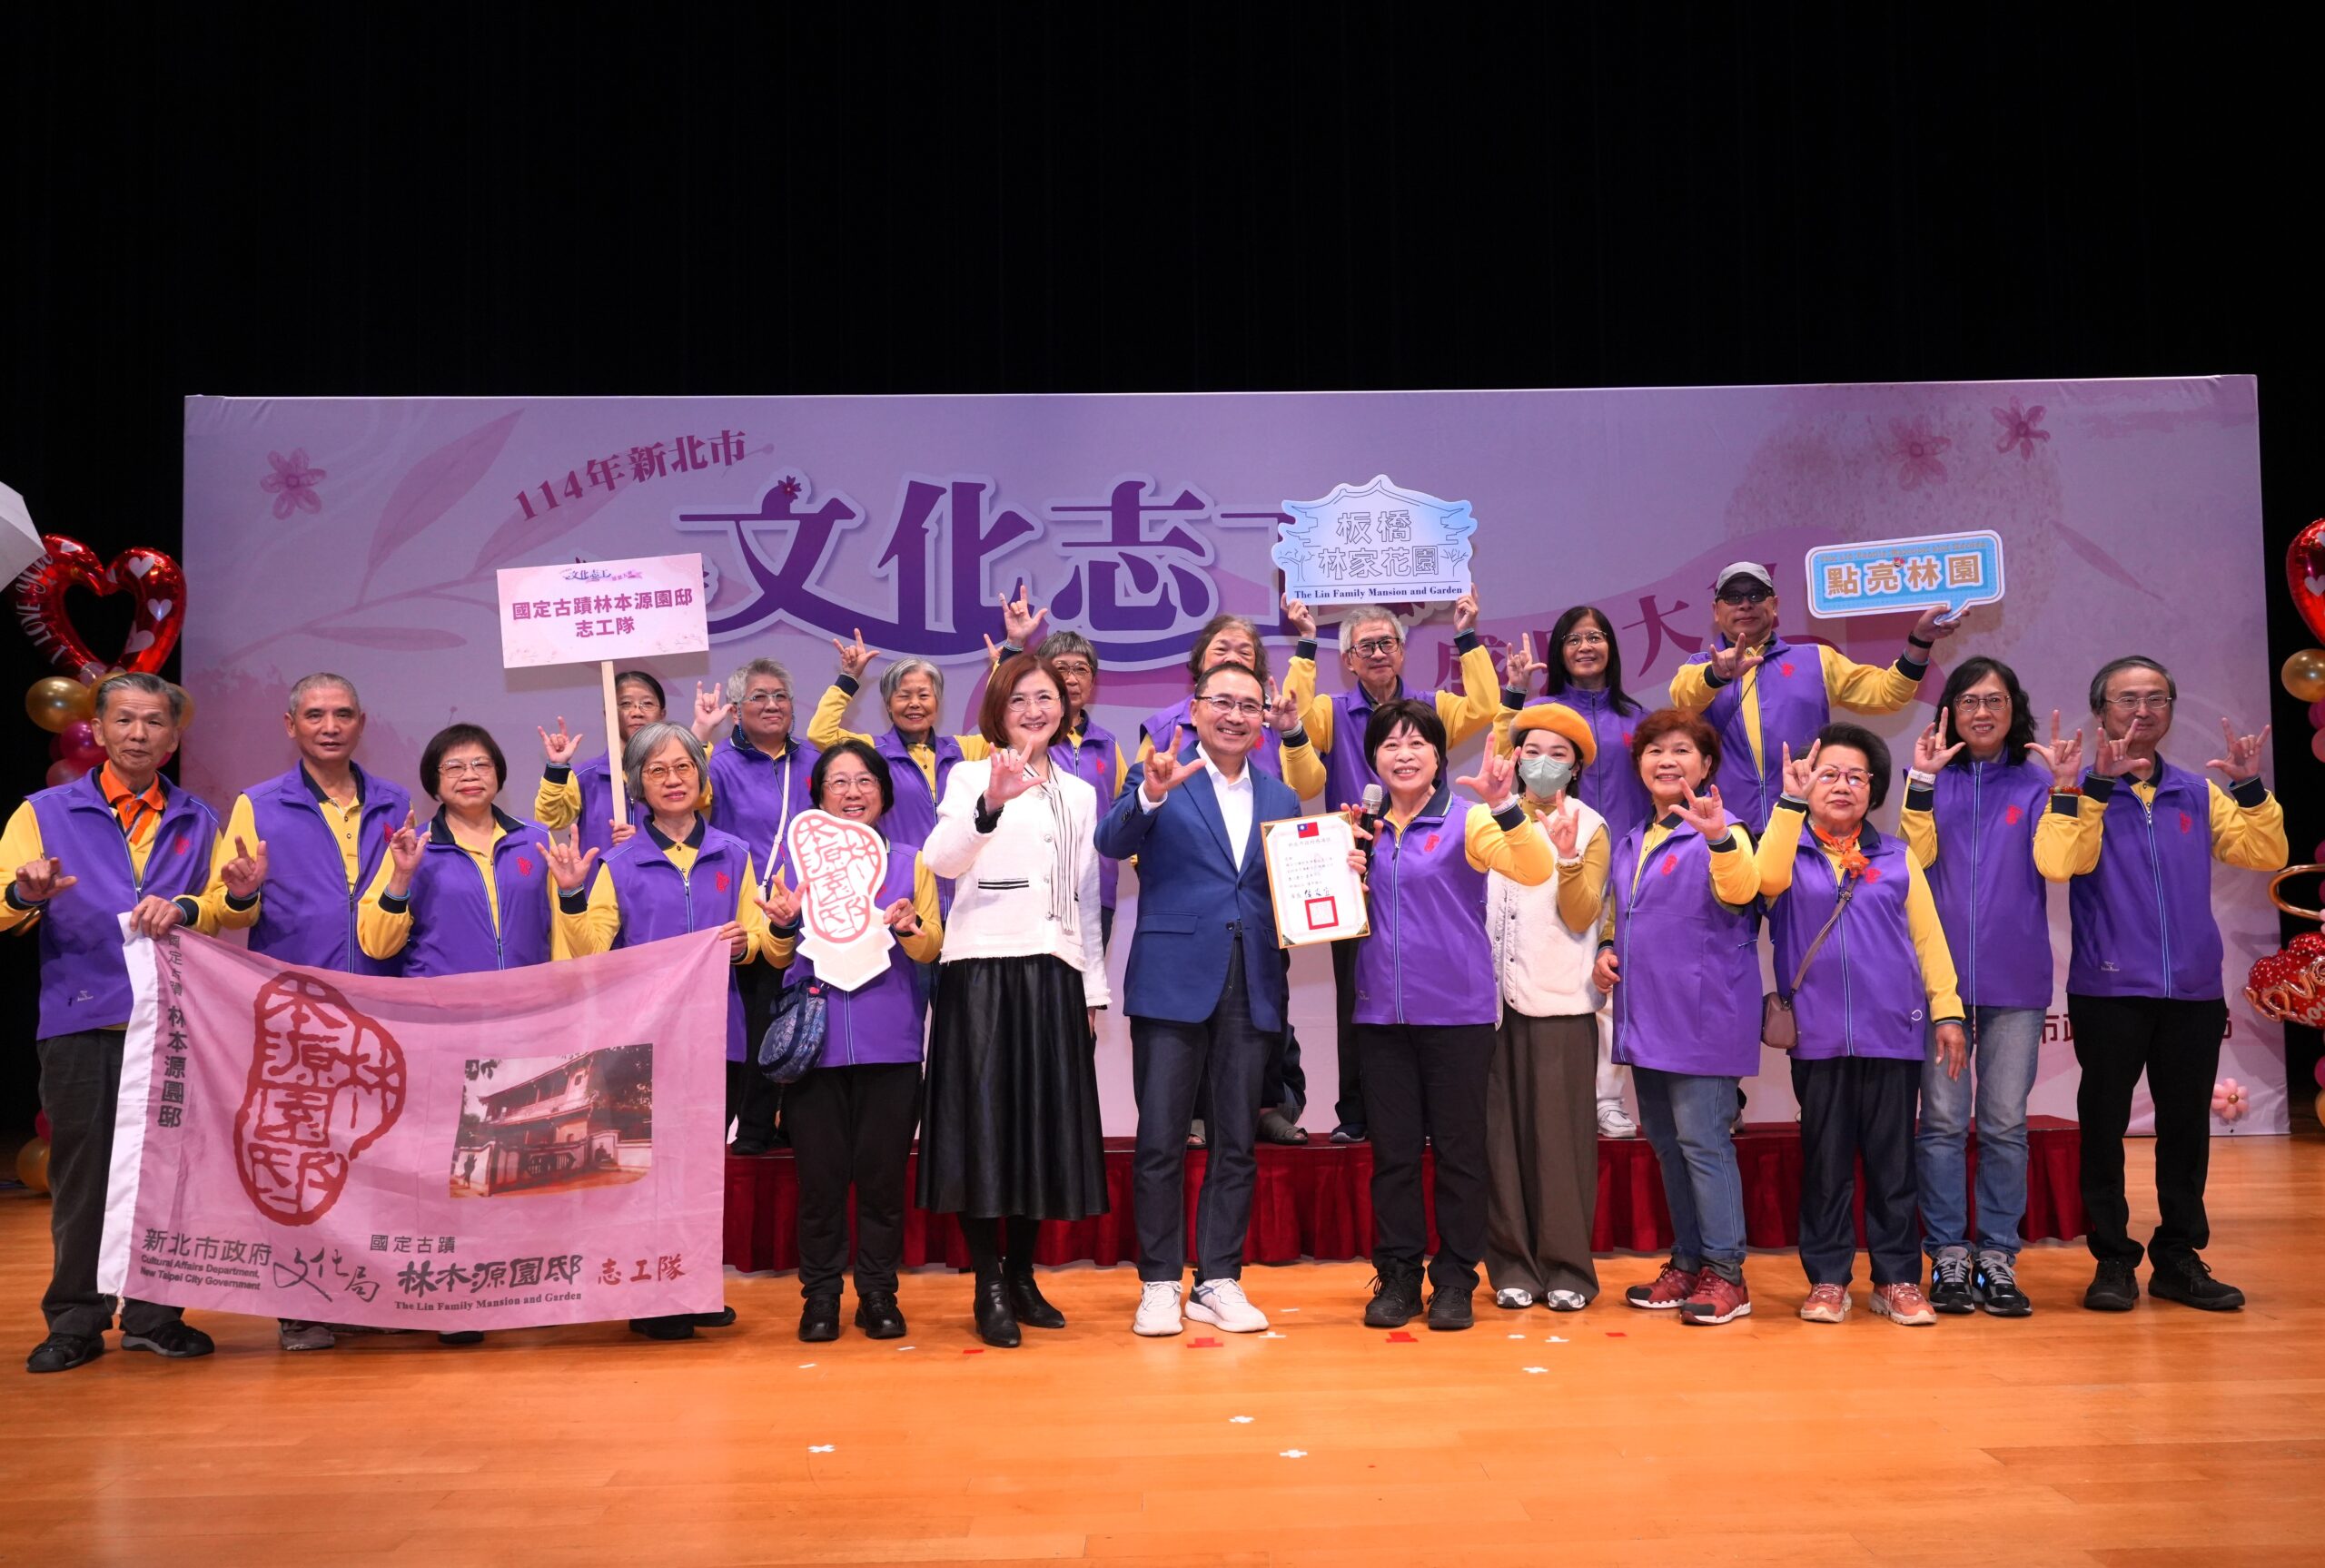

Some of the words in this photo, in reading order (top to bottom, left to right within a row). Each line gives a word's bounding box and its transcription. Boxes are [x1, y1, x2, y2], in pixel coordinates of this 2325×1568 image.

[515, 430, 746, 521] 114年新北市
[1336, 509, 1412, 545] 板橋
[679, 479, 1299, 661] 文化志
[1319, 545, 1440, 580] 林家花園
[1827, 554, 1981, 596] 點亮林園
[512, 587, 693, 620] 國定古蹟林本源園邸
[1294, 590, 1314, 599] The
[1315, 589, 1331, 598] Lin
[1333, 588, 1366, 600] Family
[1368, 587, 1408, 597] Mansion
[1410, 587, 1427, 596] and
[1430, 586, 1463, 596] Garden
[575, 616, 636, 637] 志工隊
[157, 1005, 188, 1129] 林本源園邸
[370, 1234, 457, 1254] 國定古蹟
[140, 1266, 156, 1277] New
[158, 1268, 183, 1284] Taipei
[184, 1273, 203, 1287] City
[205, 1277, 261, 1291] Government
[141, 1228, 272, 1267] 新北市政府
[272, 1247, 380, 1303] 文化局
[141, 1255, 173, 1268] Cultural
[173, 1259, 203, 1272] Affairs
[206, 1263, 260, 1279] Department,
[397, 1255, 583, 1297] 林本源園邸
[598, 1254, 686, 1286] 志工隊
[394, 1301, 414, 1311] The
[416, 1300, 434, 1311] Lin
[437, 1299, 473, 1313] Family
[476, 1297, 520, 1309] Mansion
[523, 1294, 542, 1305] and
[544, 1291, 581, 1302] Garden
